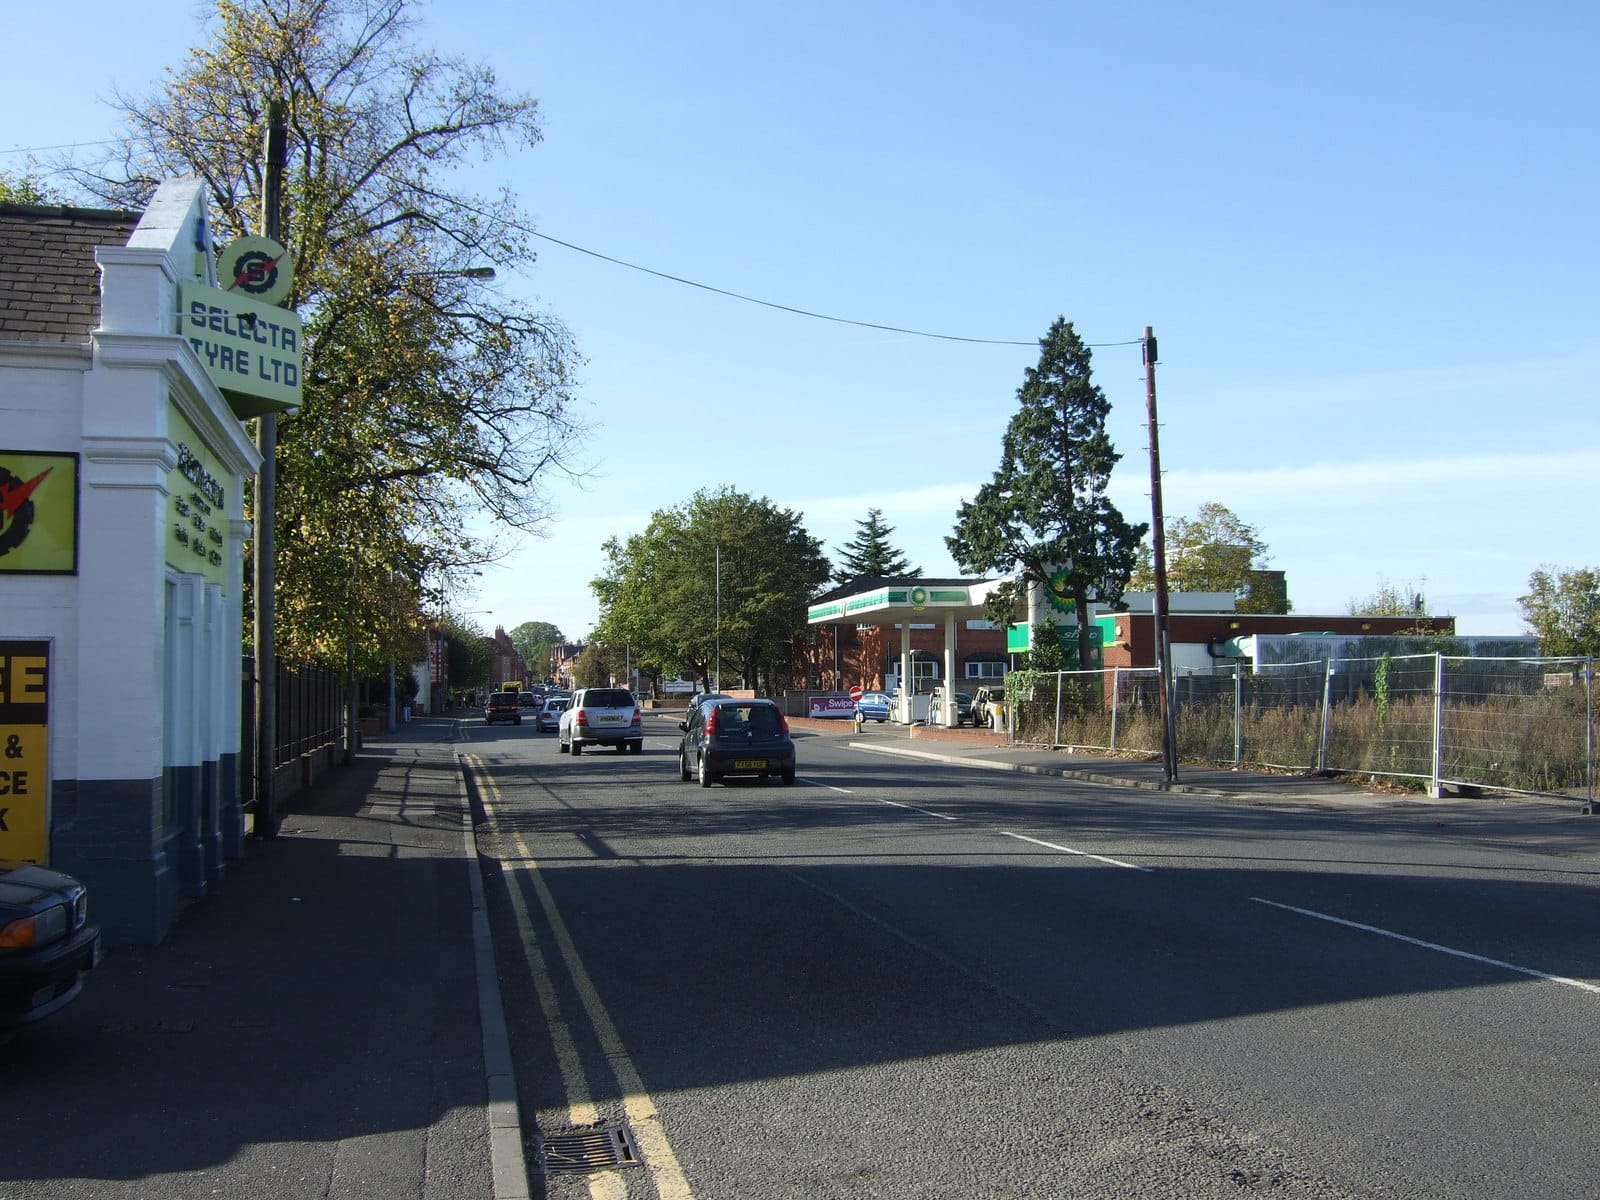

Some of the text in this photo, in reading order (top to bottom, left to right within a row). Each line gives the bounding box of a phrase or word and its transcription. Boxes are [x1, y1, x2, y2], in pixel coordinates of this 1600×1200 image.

[190, 300, 297, 352] SELECTA
[190, 337, 297, 387] TYRE LTD
[829, 699, 853, 709] Swipe
[5, 734, 24, 759] &
